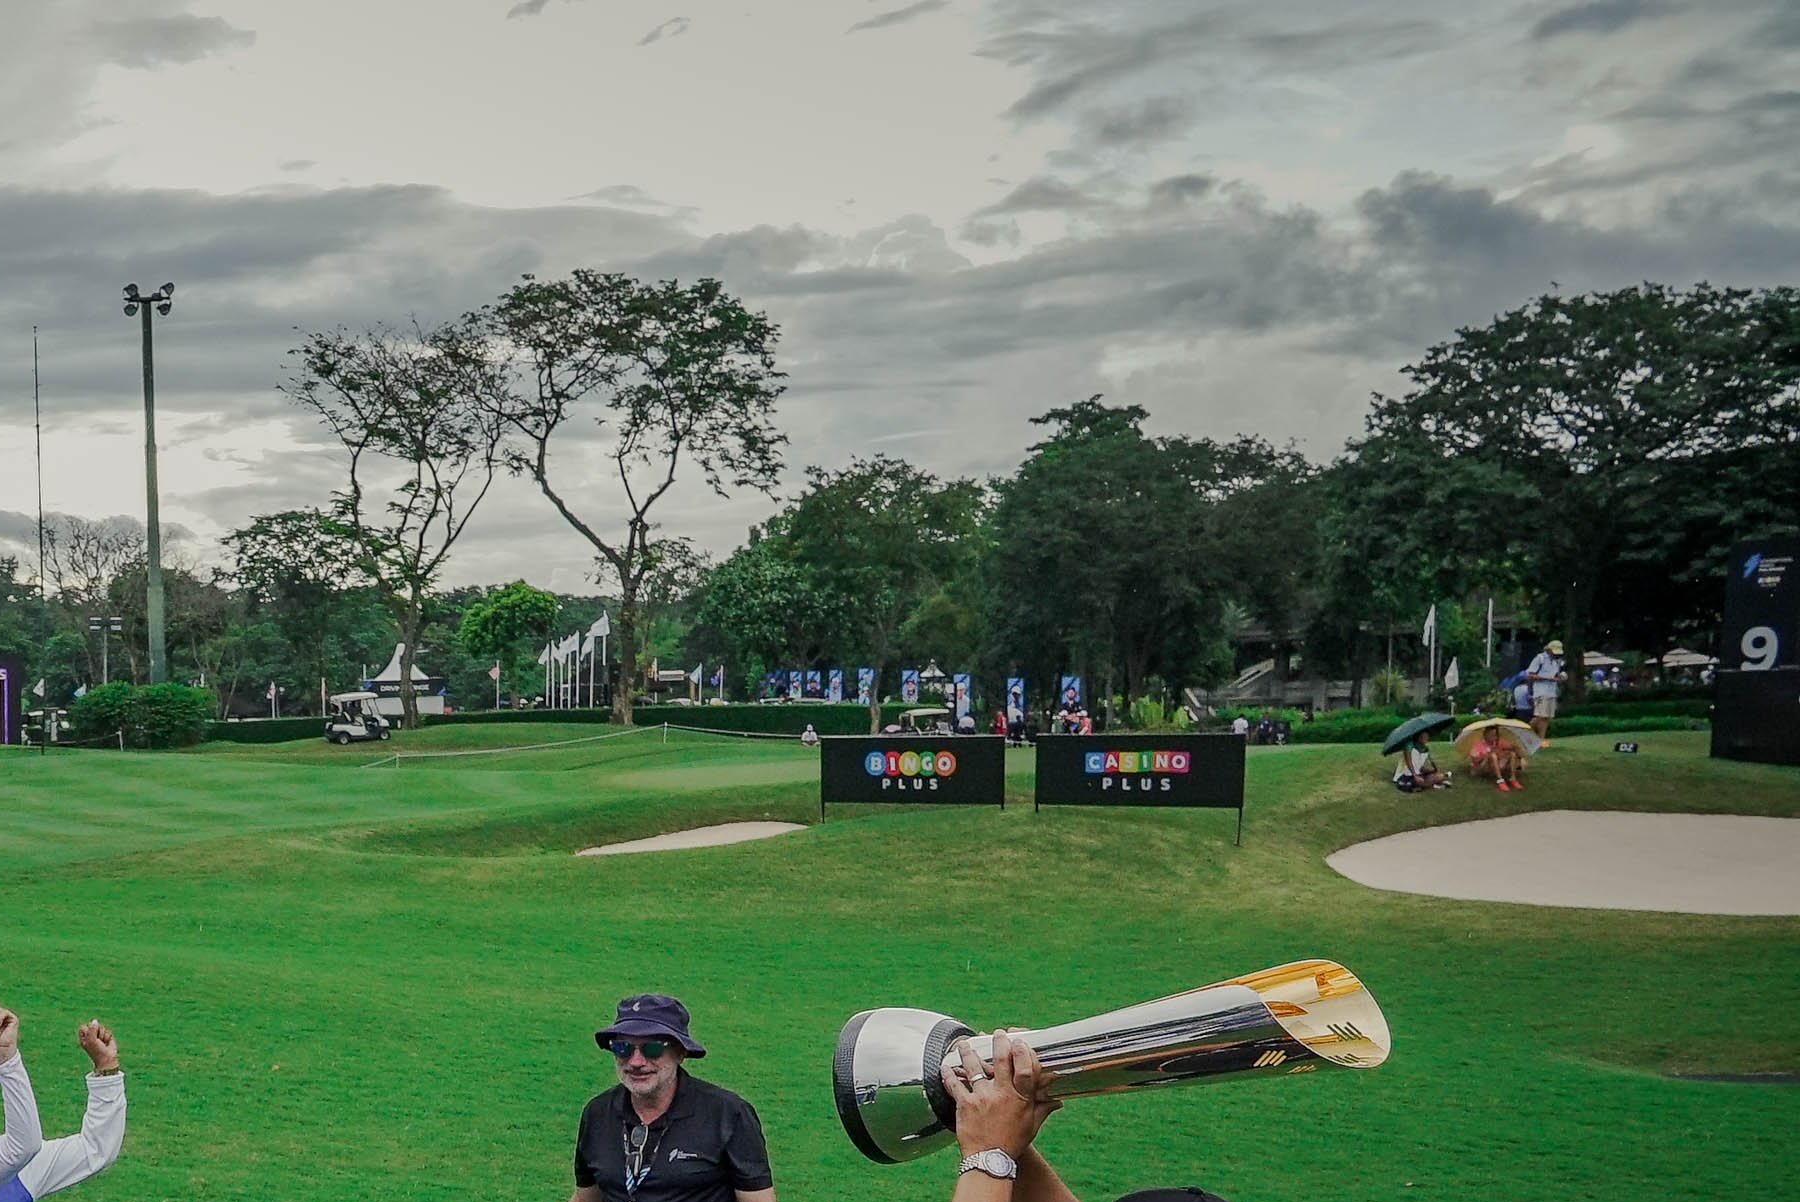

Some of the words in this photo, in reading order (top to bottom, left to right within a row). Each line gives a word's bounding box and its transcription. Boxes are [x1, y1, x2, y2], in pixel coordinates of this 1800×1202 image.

[1741, 626, 1778, 671] 9
[867, 752, 954, 774] BINGO
[1086, 752, 1188, 772] CASINO
[882, 778, 938, 790] PLUS
[1102, 777, 1171, 791] PLUS
